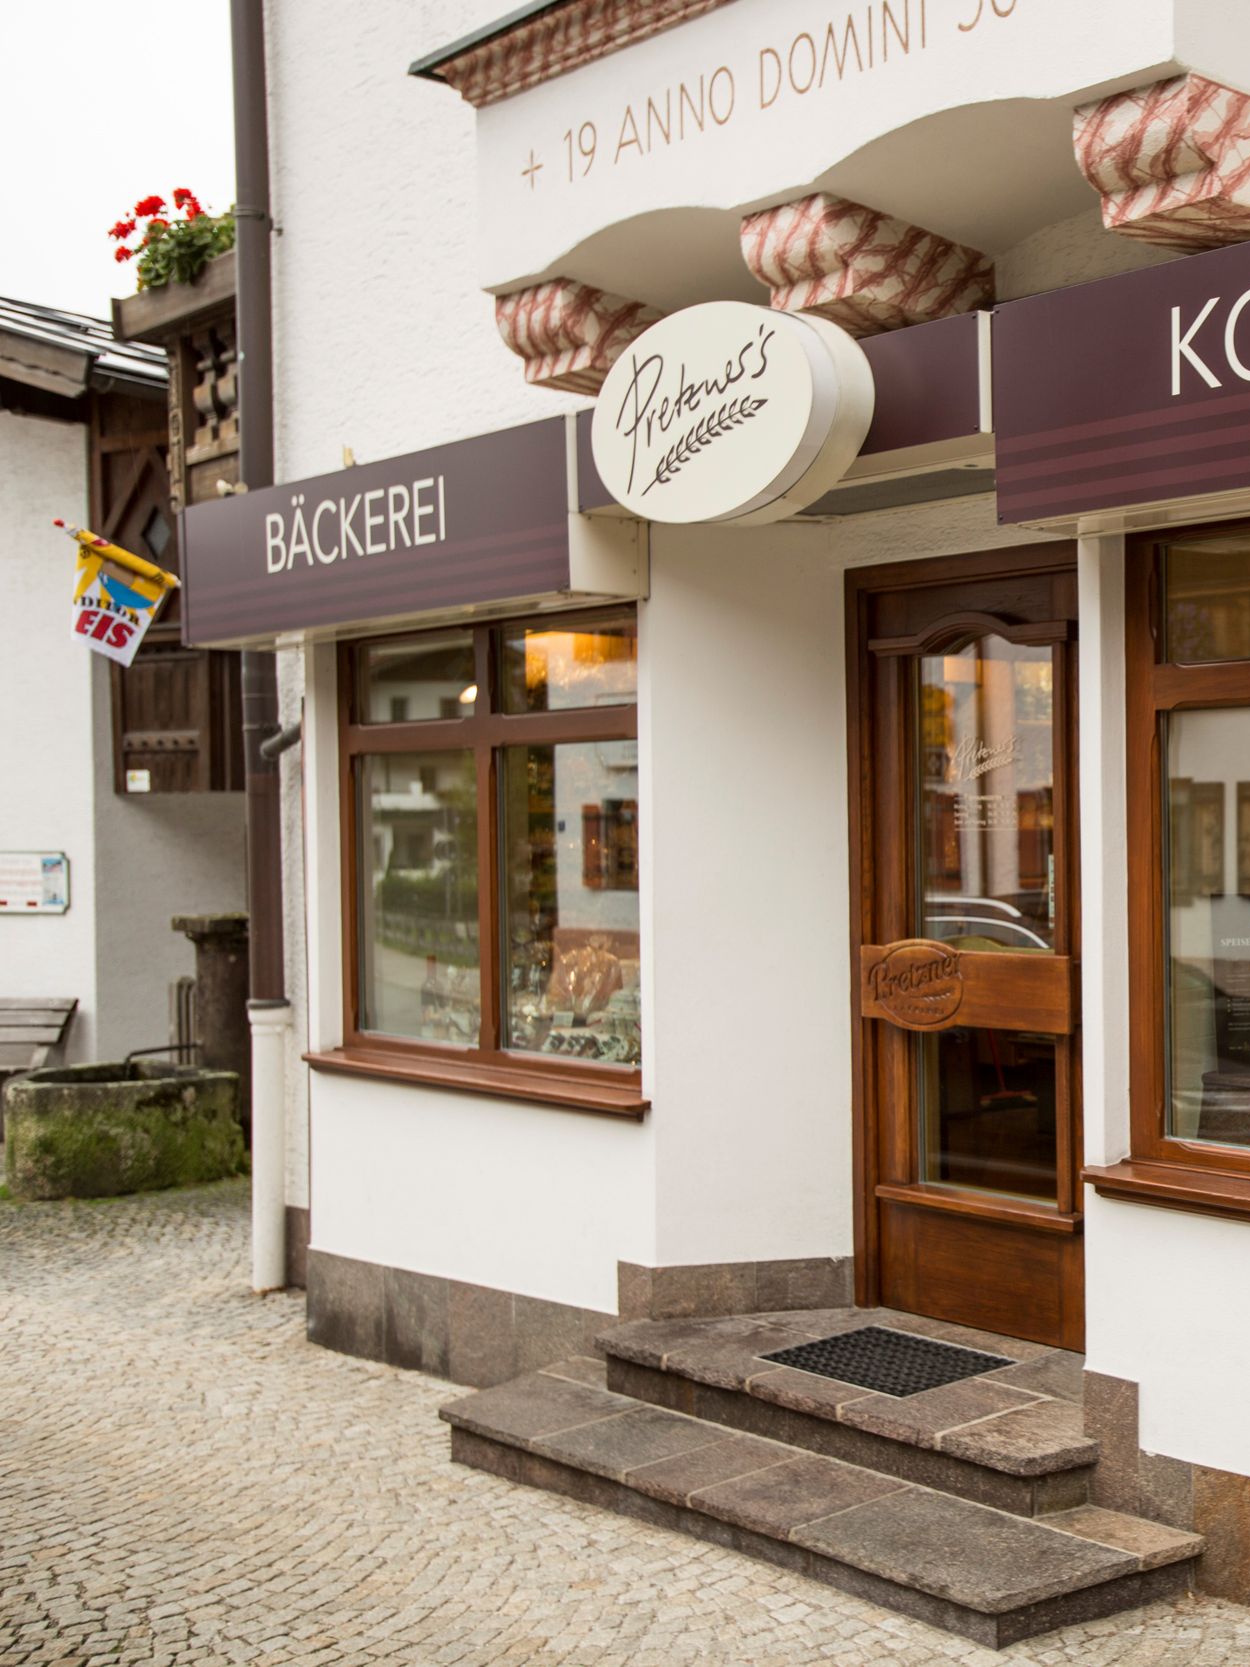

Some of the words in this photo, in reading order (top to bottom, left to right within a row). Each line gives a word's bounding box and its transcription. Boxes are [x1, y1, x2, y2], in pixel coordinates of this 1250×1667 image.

[563, 121, 598, 184] 19
[613, 65, 736, 166] ANNO
[759, 0, 927, 110] DOMINI
[265, 474, 446, 575] BÄCKEREI
[75, 609, 135, 649] EIS
